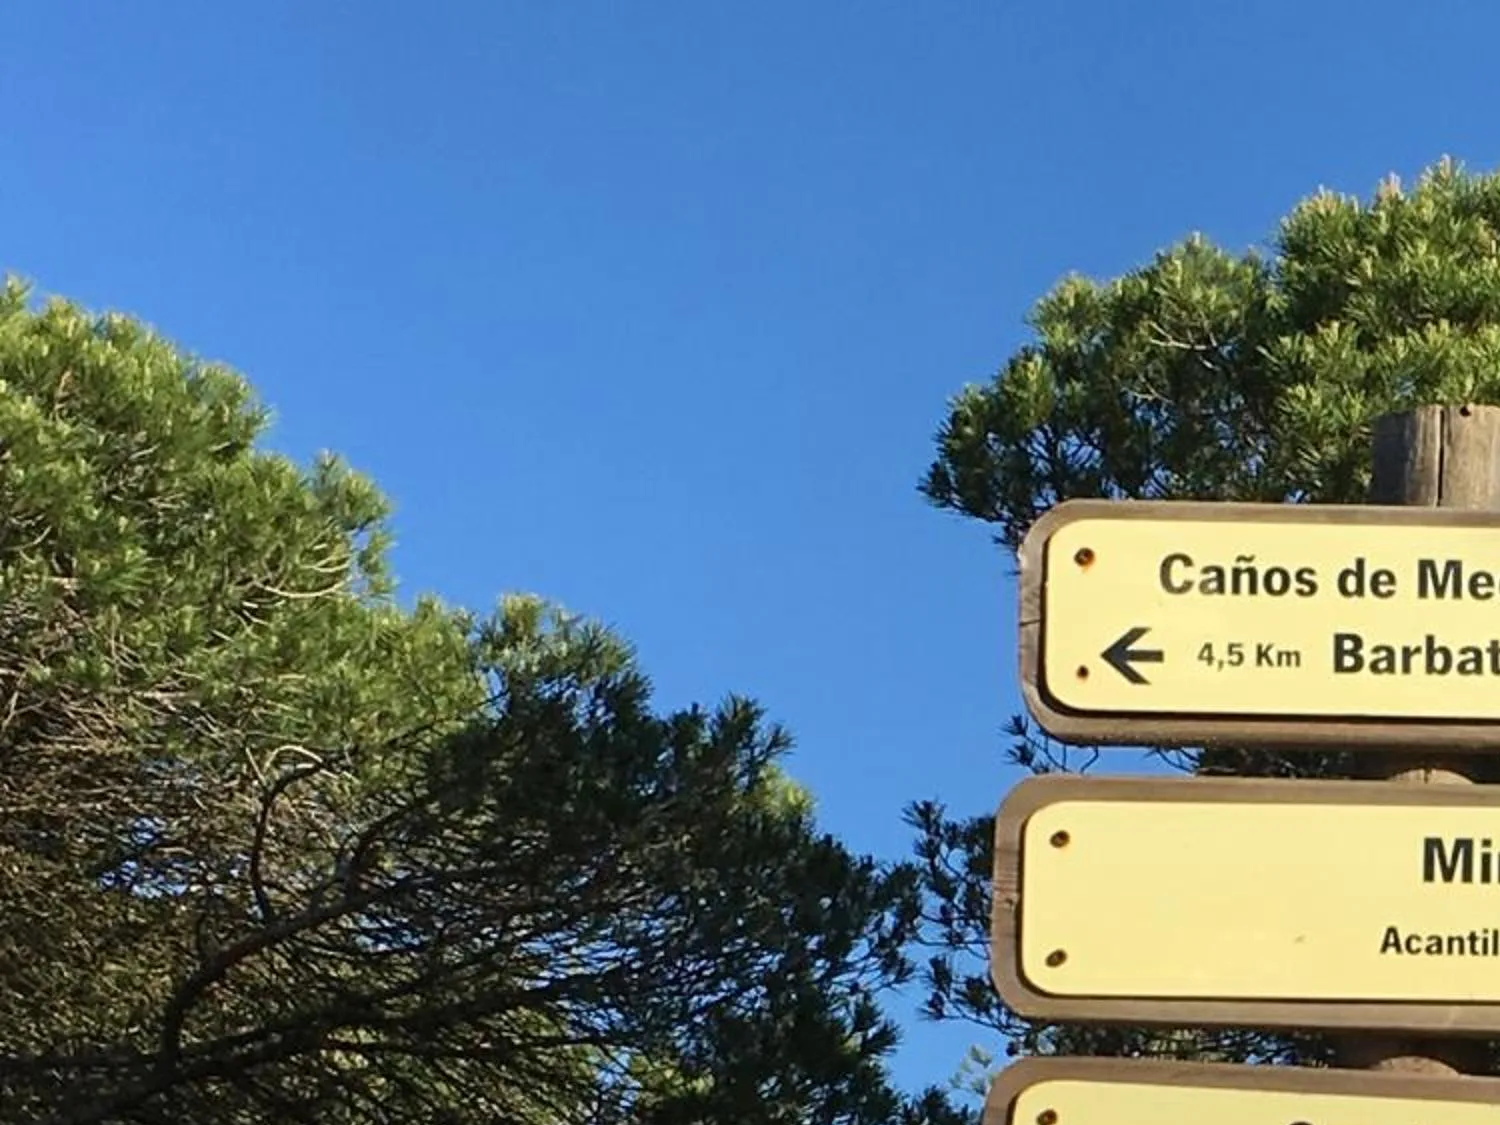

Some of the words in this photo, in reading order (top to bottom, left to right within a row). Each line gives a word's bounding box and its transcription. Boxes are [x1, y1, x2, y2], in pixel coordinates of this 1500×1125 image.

[1159, 553, 1318, 598] Caños
[1337, 557, 1397, 599] de
[1197, 642, 1245, 670] 4,5
[1255, 643, 1301, 668] Km
